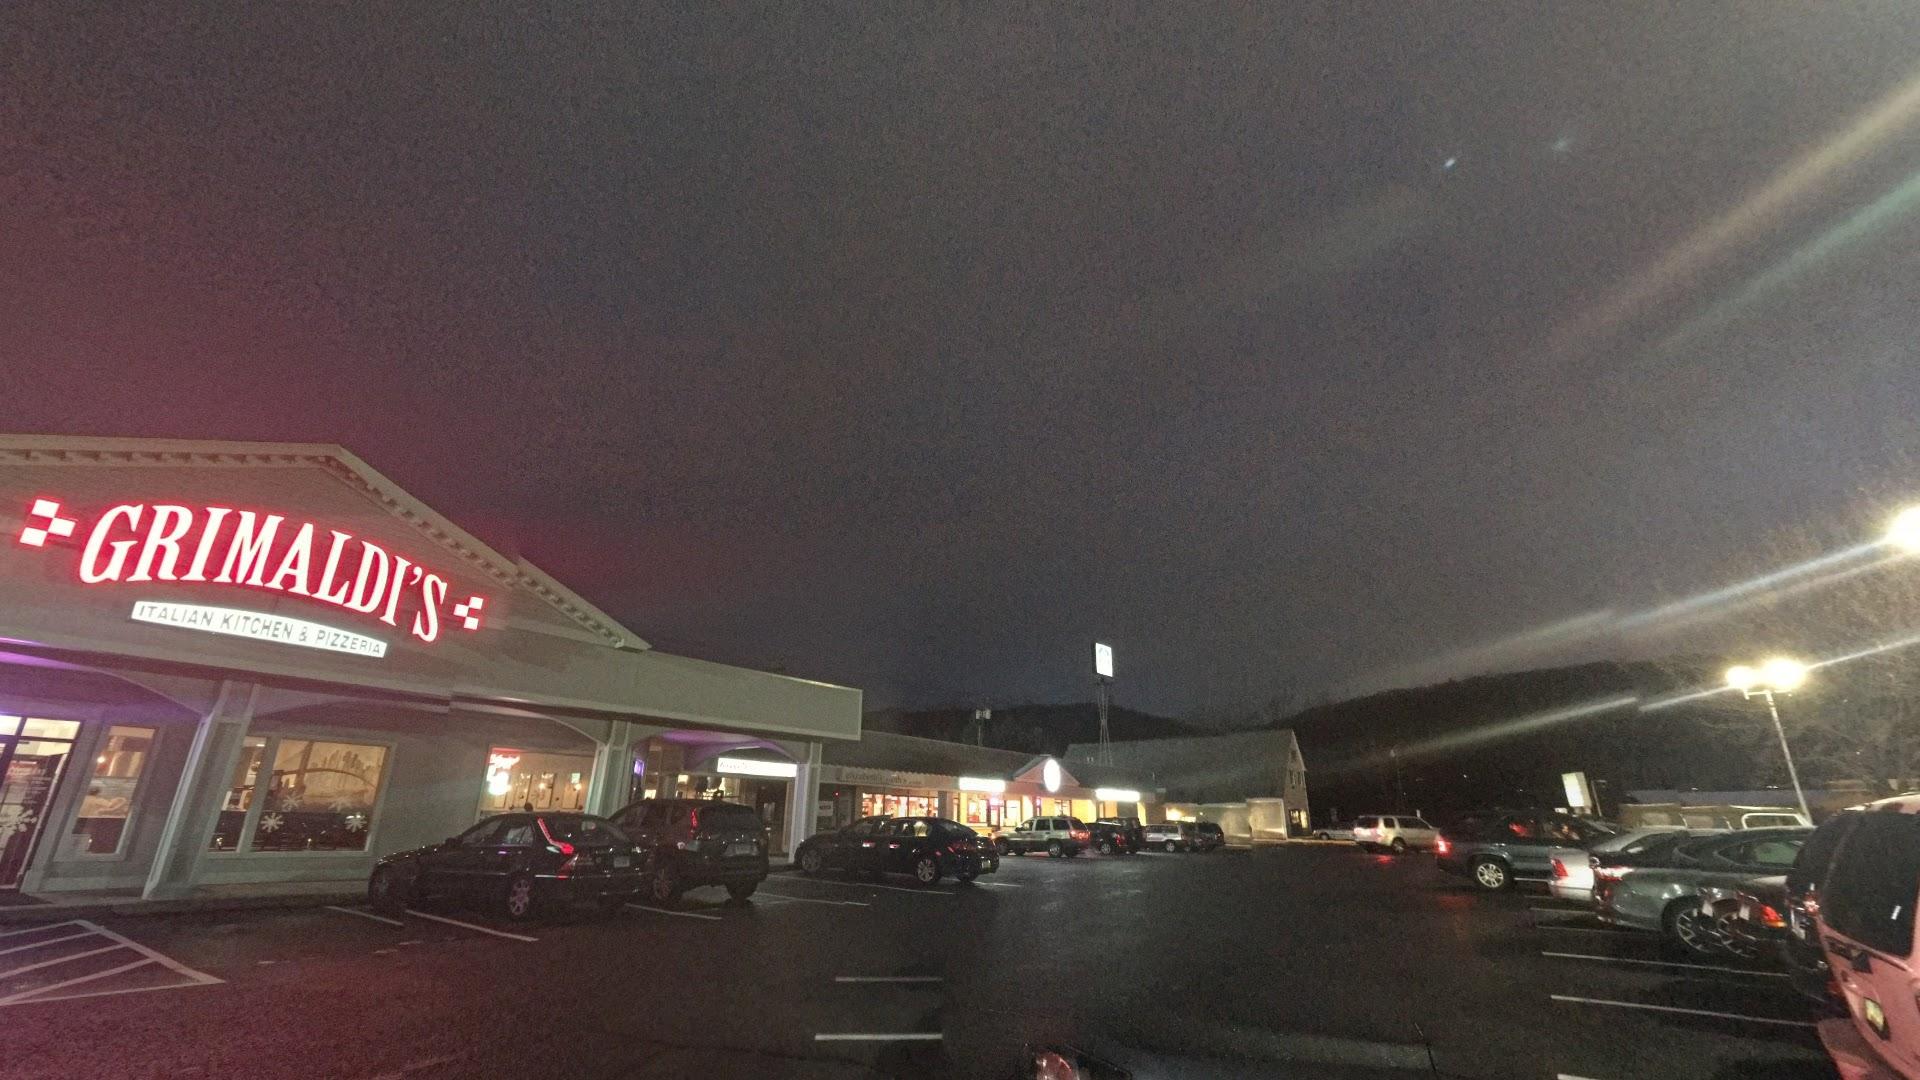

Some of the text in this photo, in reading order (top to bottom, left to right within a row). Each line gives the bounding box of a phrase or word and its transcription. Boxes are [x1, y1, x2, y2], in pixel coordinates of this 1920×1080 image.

[79, 504, 448, 642] GRIMALDI'S
[139, 605, 381, 655] ITALIAN KITCHEN & PIZZERIA
